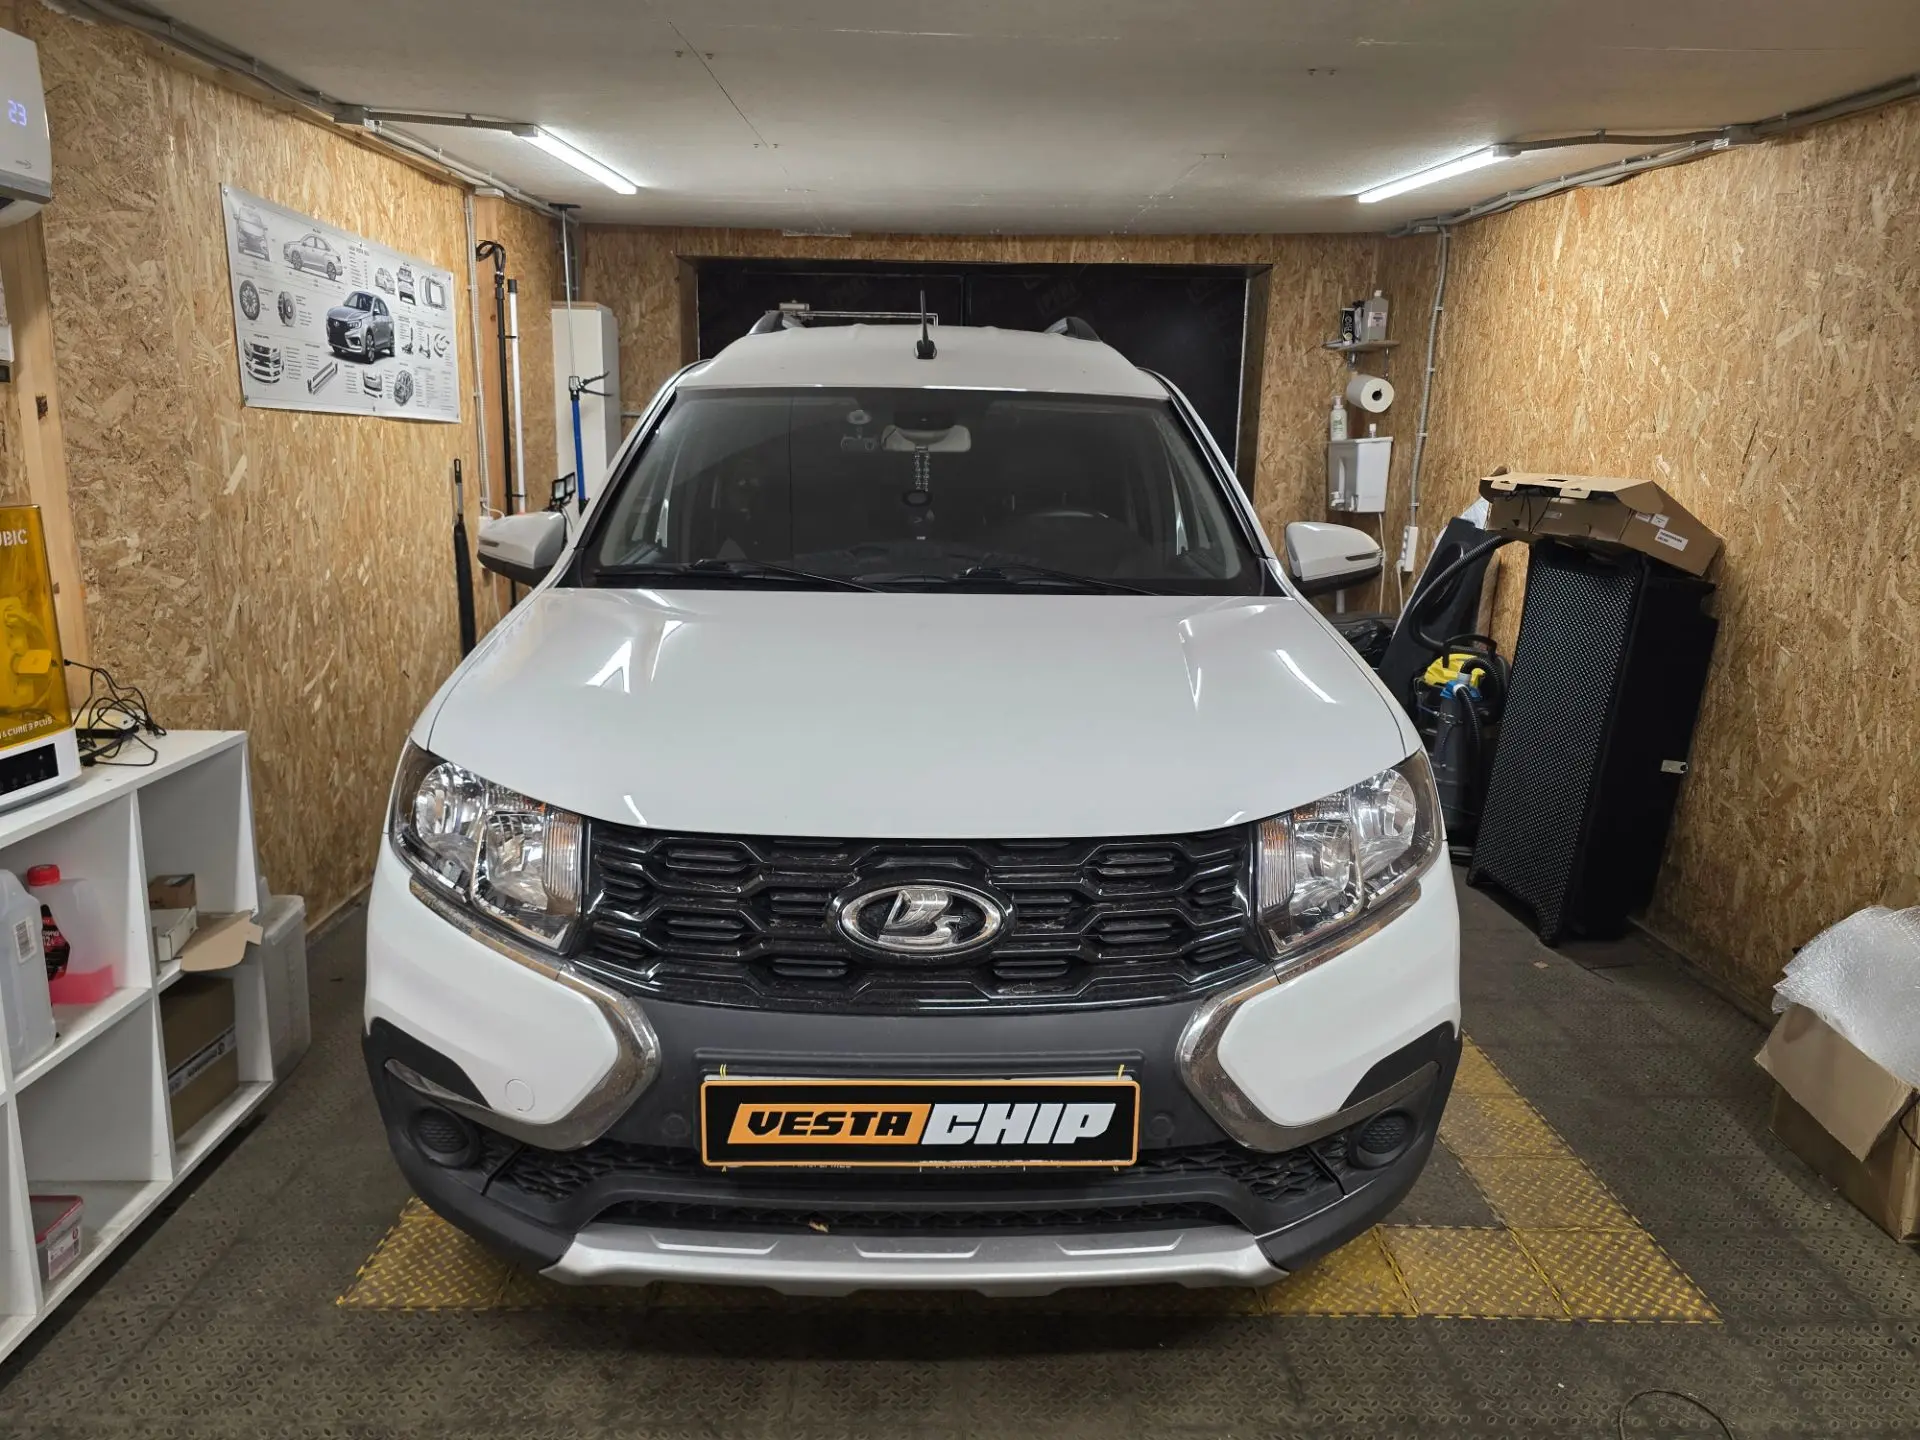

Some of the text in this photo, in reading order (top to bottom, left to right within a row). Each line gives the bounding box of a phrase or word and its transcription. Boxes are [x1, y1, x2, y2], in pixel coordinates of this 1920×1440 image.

[7, 99, 27, 127] 23
[0, 529, 28, 547] BIC
[34, 716, 53, 728] PLUS
[747, 1103, 1116, 1145] VESTA CHIP
